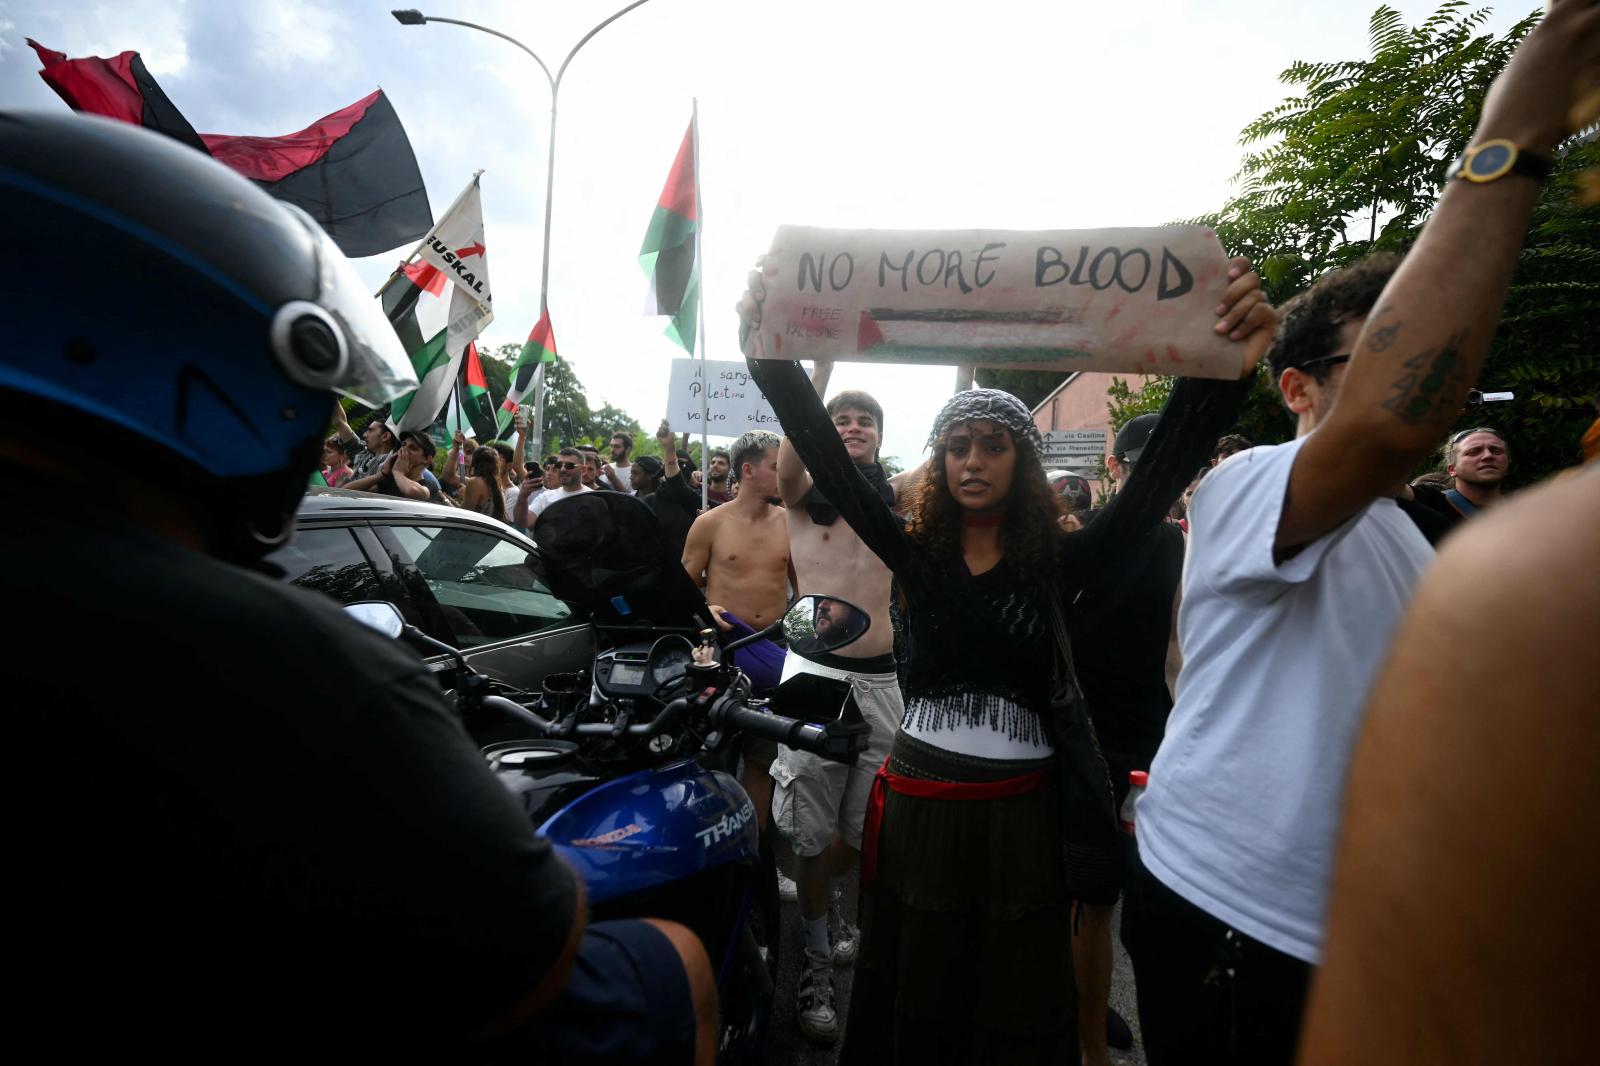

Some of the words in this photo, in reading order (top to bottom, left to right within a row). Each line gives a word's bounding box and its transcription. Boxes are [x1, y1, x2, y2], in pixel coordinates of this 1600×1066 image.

[797, 252, 854, 293] NO
[878, 242, 1007, 295] MORE
[1035, 245, 1194, 301] BLOOD
[802, 306, 843, 321] FREE
[687, 407, 727, 422] votro
